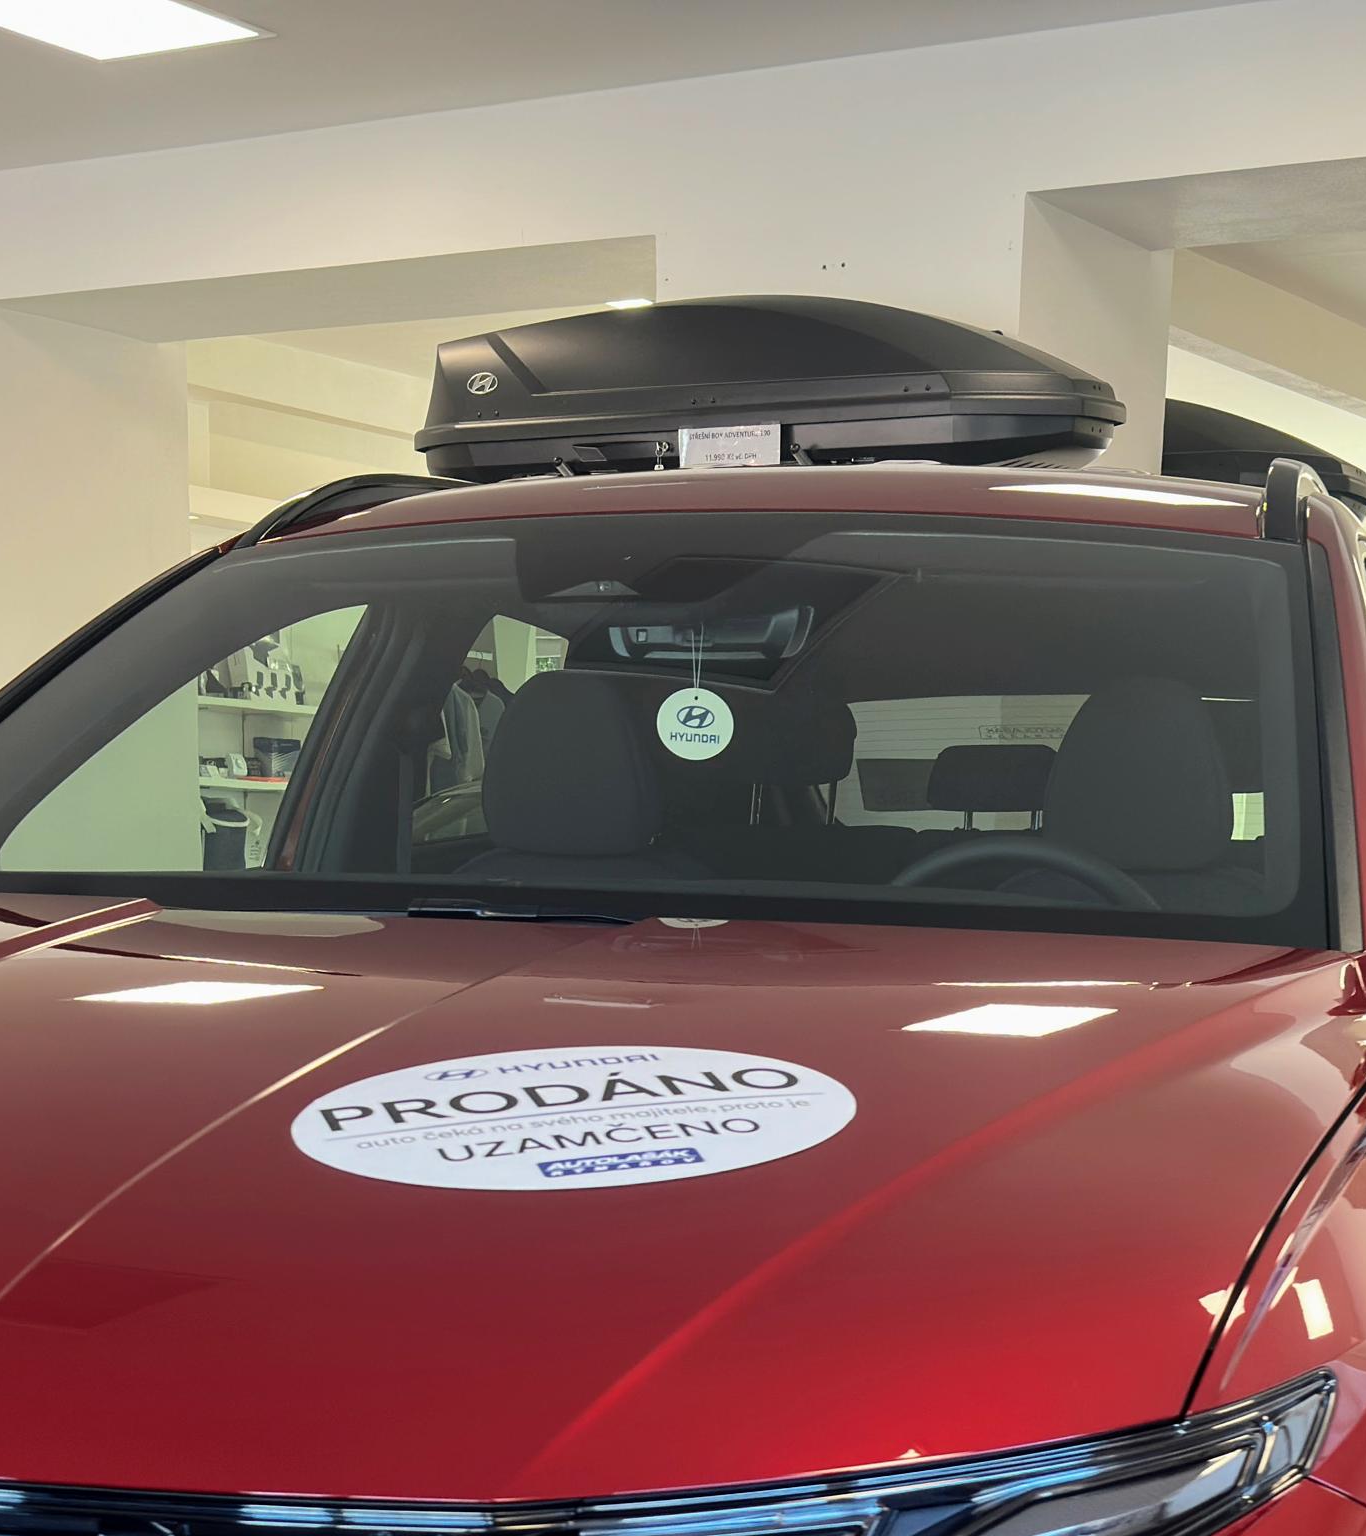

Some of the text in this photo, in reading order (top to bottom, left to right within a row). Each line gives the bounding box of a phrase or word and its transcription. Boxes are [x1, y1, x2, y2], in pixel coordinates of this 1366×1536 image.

[669, 731, 721, 745] HYUNDAI
[496, 1053, 661, 1075] HYUNDAI
[319, 1067, 799, 1132] PRODÁNO
[356, 1134, 416, 1150] auto
[422, 1122, 485, 1141] čeká
[490, 1121, 523, 1133] na
[528, 1109, 608, 1129] svého
[718, 1099, 784, 1117] proto
[785, 1097, 811, 1109] je
[436, 1117, 761, 1163] UZAMČENO
